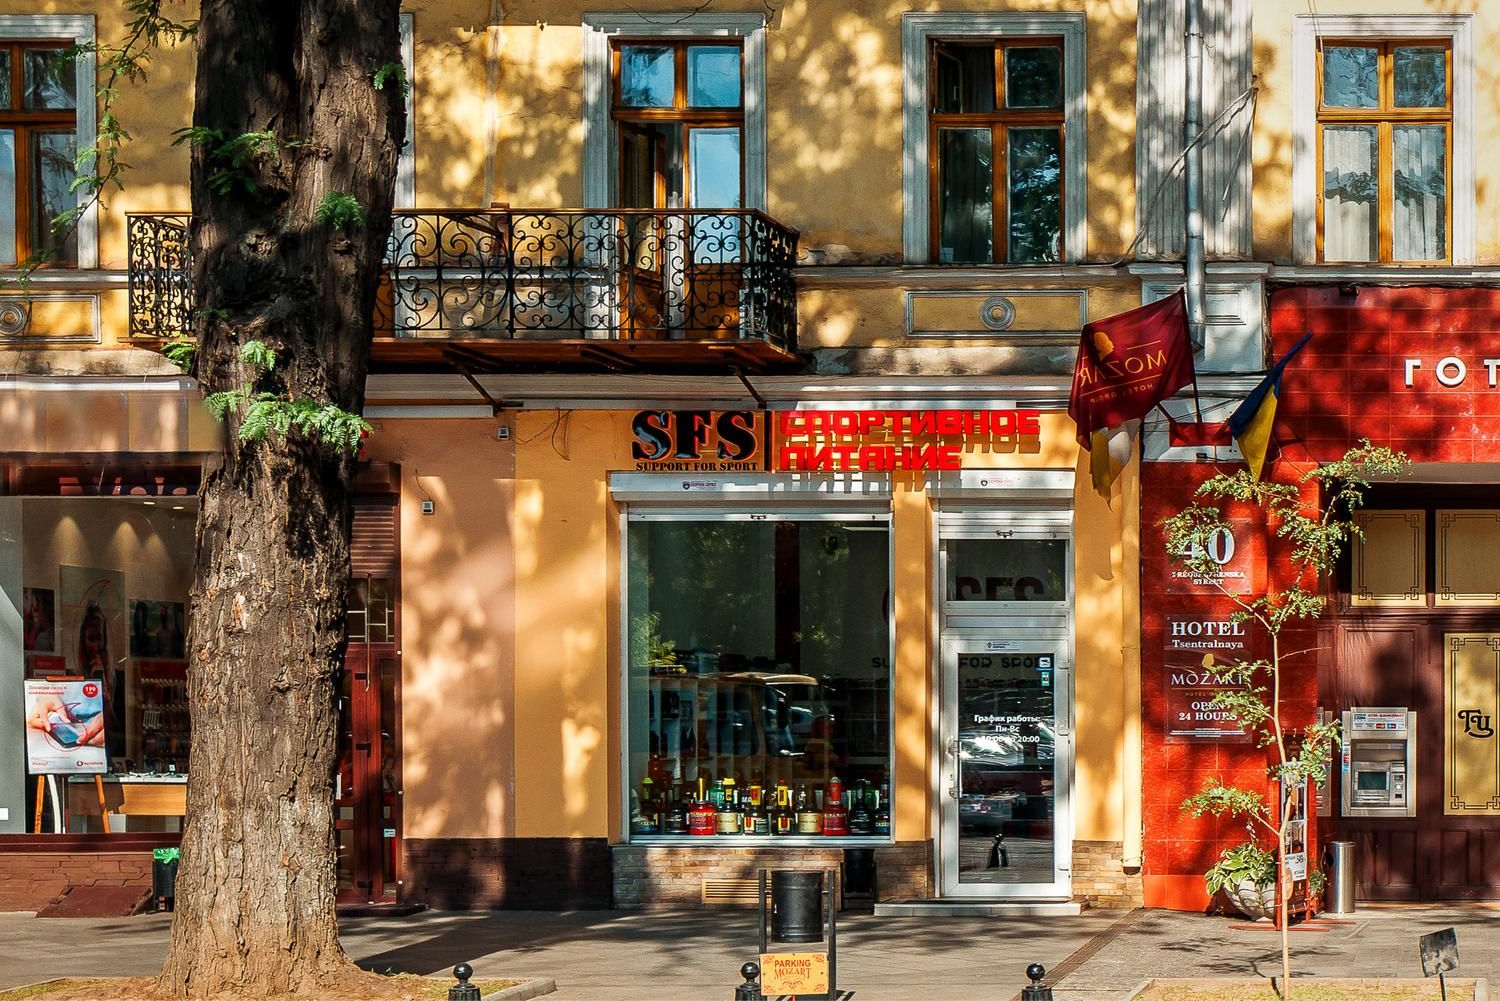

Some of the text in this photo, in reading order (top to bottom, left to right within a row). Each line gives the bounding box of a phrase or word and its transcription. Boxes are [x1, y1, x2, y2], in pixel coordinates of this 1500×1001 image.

[780, 410, 1041, 435] СПОРТИВНОЕ
[632, 410, 758, 461] SFS
[780, 446, 962, 471] ПИТАНИЕ
[636, 462, 758, 472] SUPPORT FOR SPORT
[1171, 622, 1245, 636] HOTEL
[1172, 640, 1244, 650] Tsentralnaya
[1191, 702, 1226, 710] OPEN
[974, 714, 1041, 723] График работы:
[1179, 712, 1238, 720] 24 HOURS
[1017, 735, 1040, 743] 20:00
[774, 959, 812, 968] PARKING
[774, 967, 812, 980] MOZART
